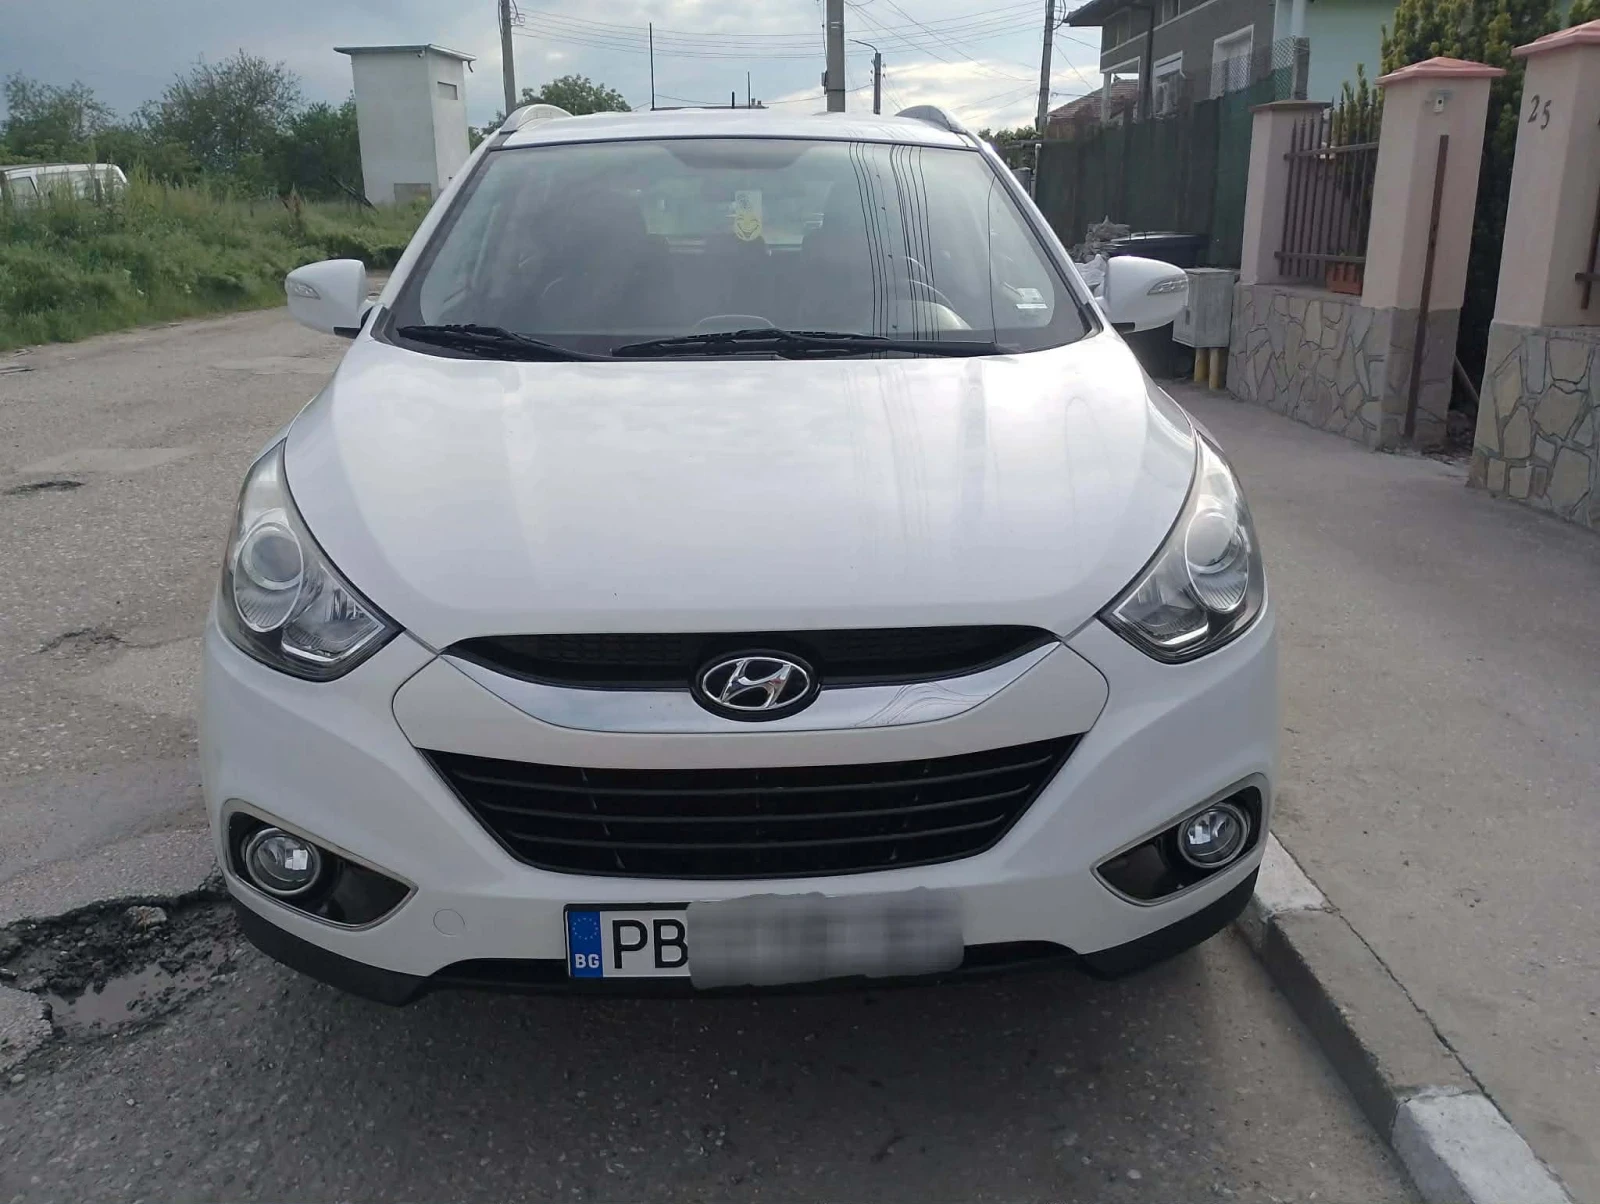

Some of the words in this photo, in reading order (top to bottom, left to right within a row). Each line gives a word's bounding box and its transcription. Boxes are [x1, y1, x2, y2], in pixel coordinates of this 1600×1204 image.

[1528, 94, 1552, 130] 25
[575, 953, 600, 968] BG
[612, 918, 689, 969] PB
